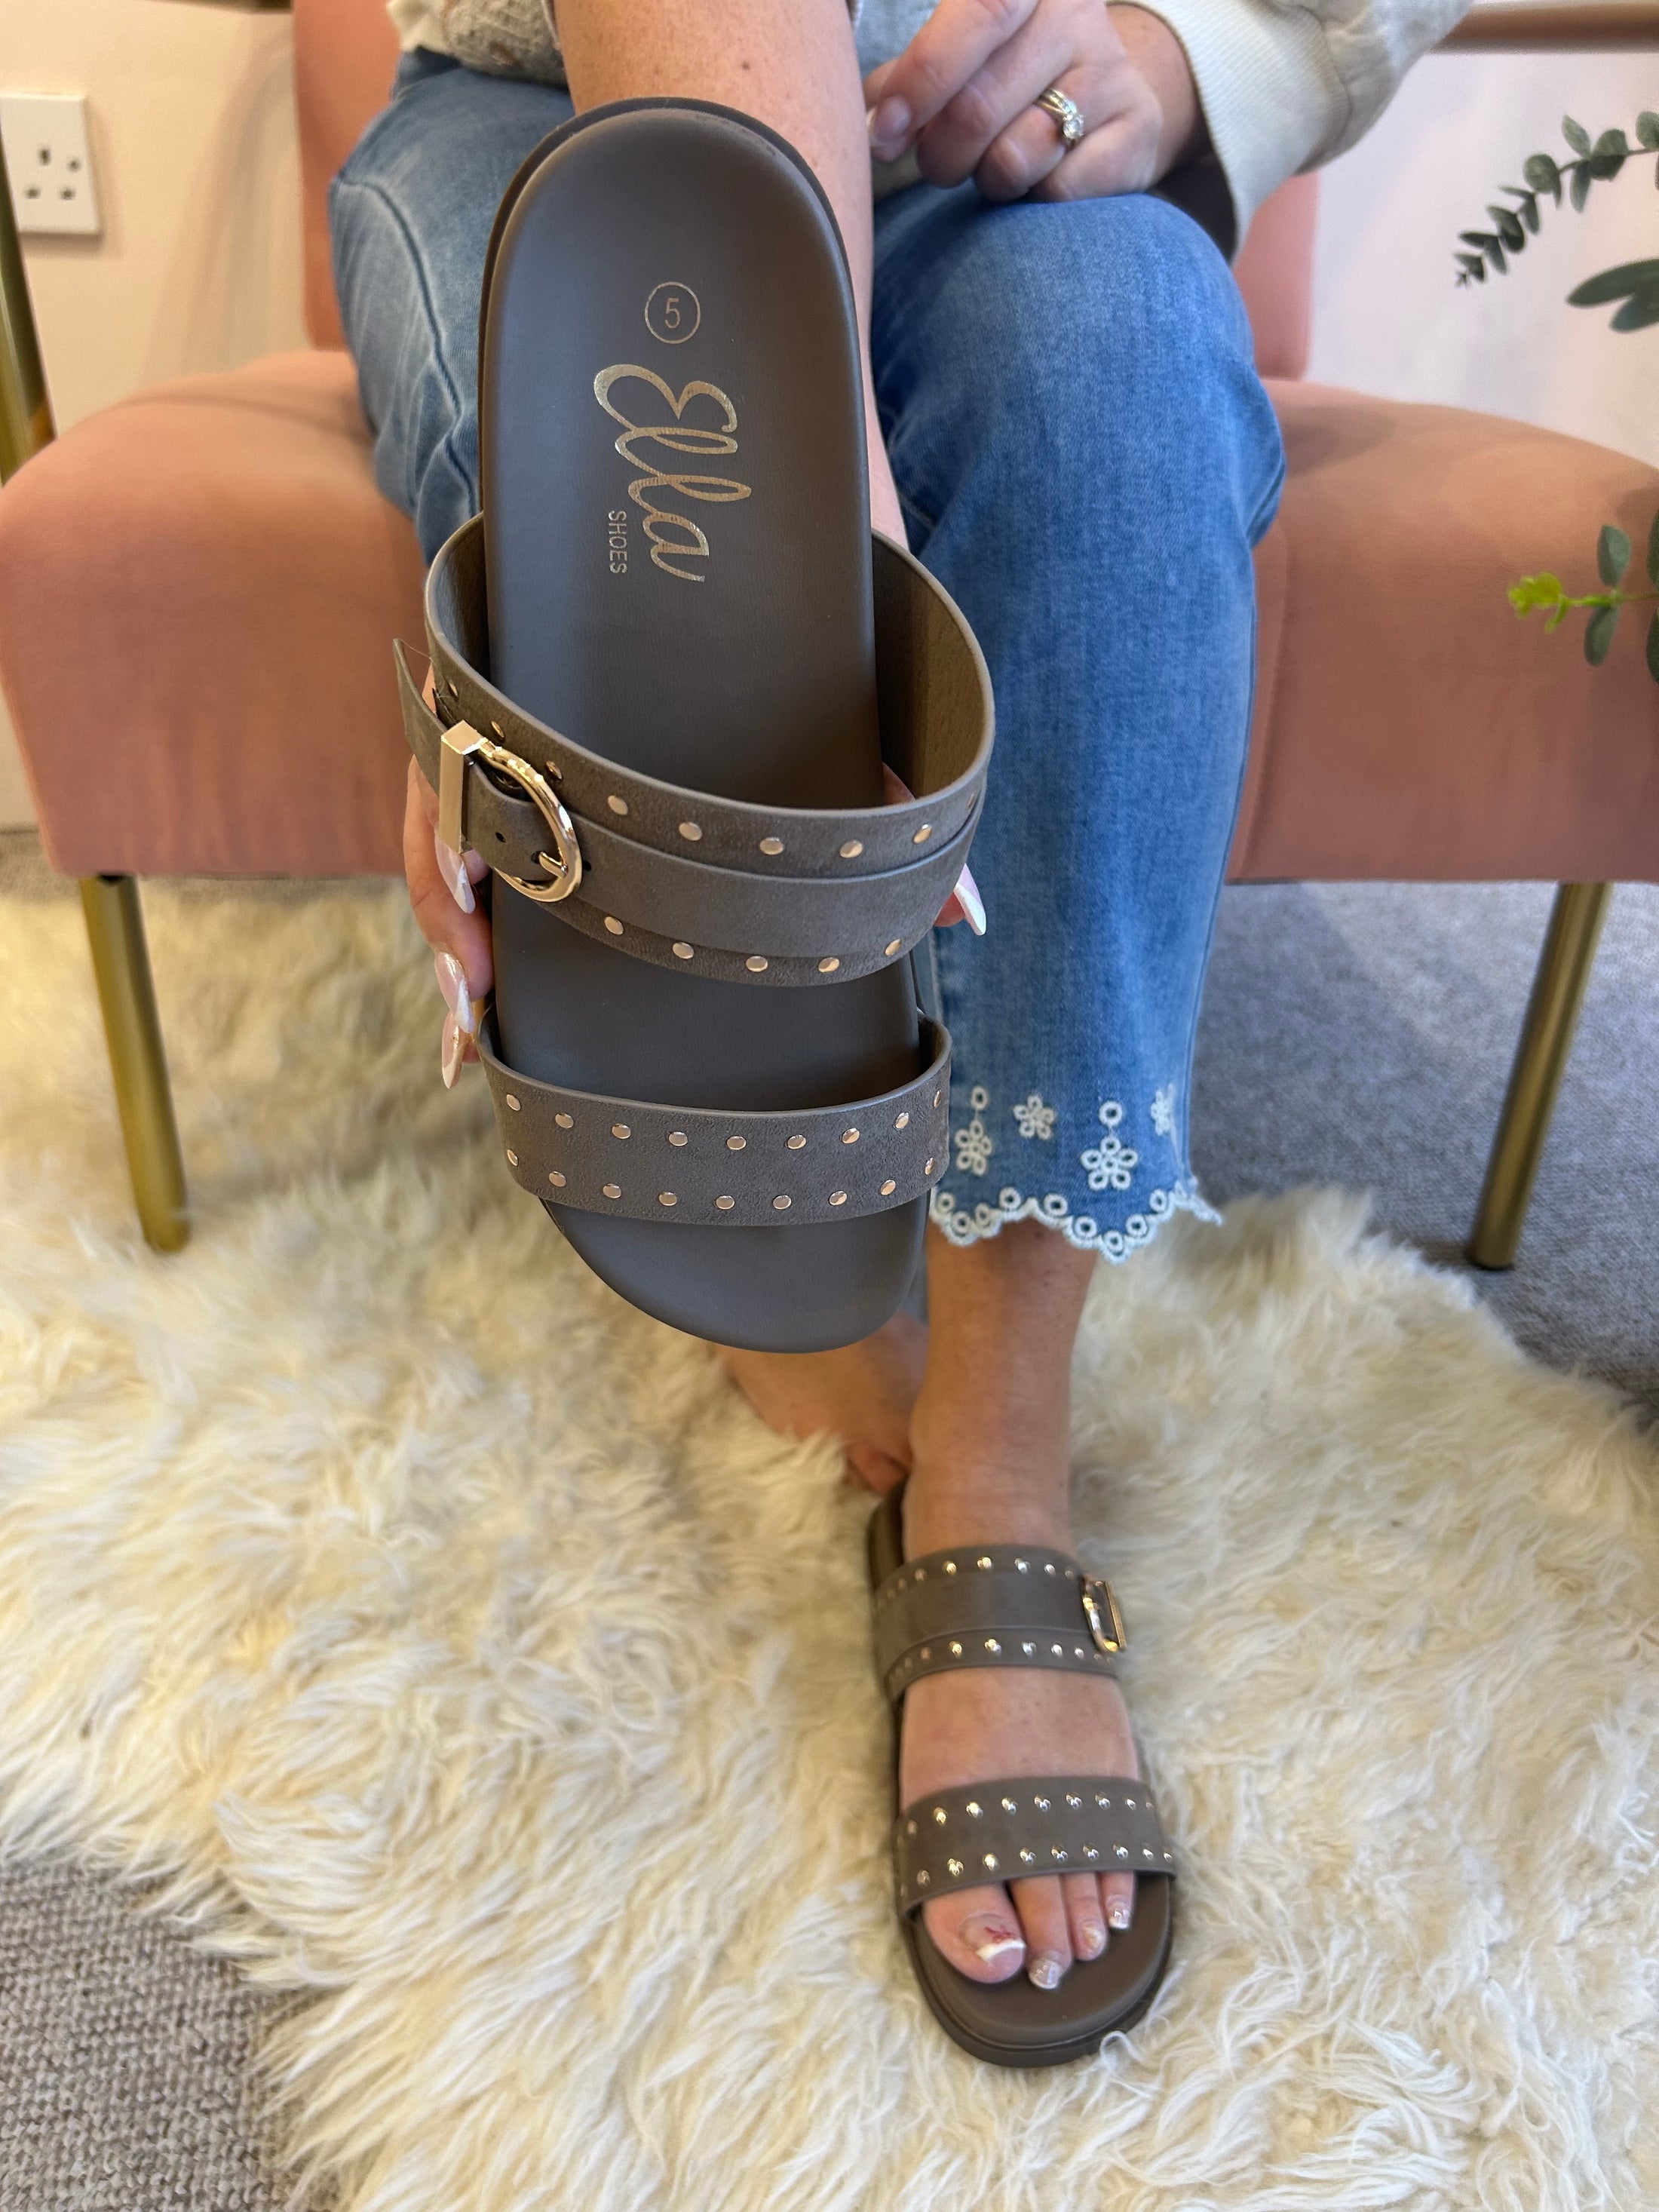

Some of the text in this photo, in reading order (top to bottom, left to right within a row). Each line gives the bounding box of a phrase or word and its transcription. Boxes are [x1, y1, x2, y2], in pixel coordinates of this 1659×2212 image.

[664, 297, 680, 329] 5
[593, 364, 752, 582] Ella
[608, 510, 627, 574] SHOES
